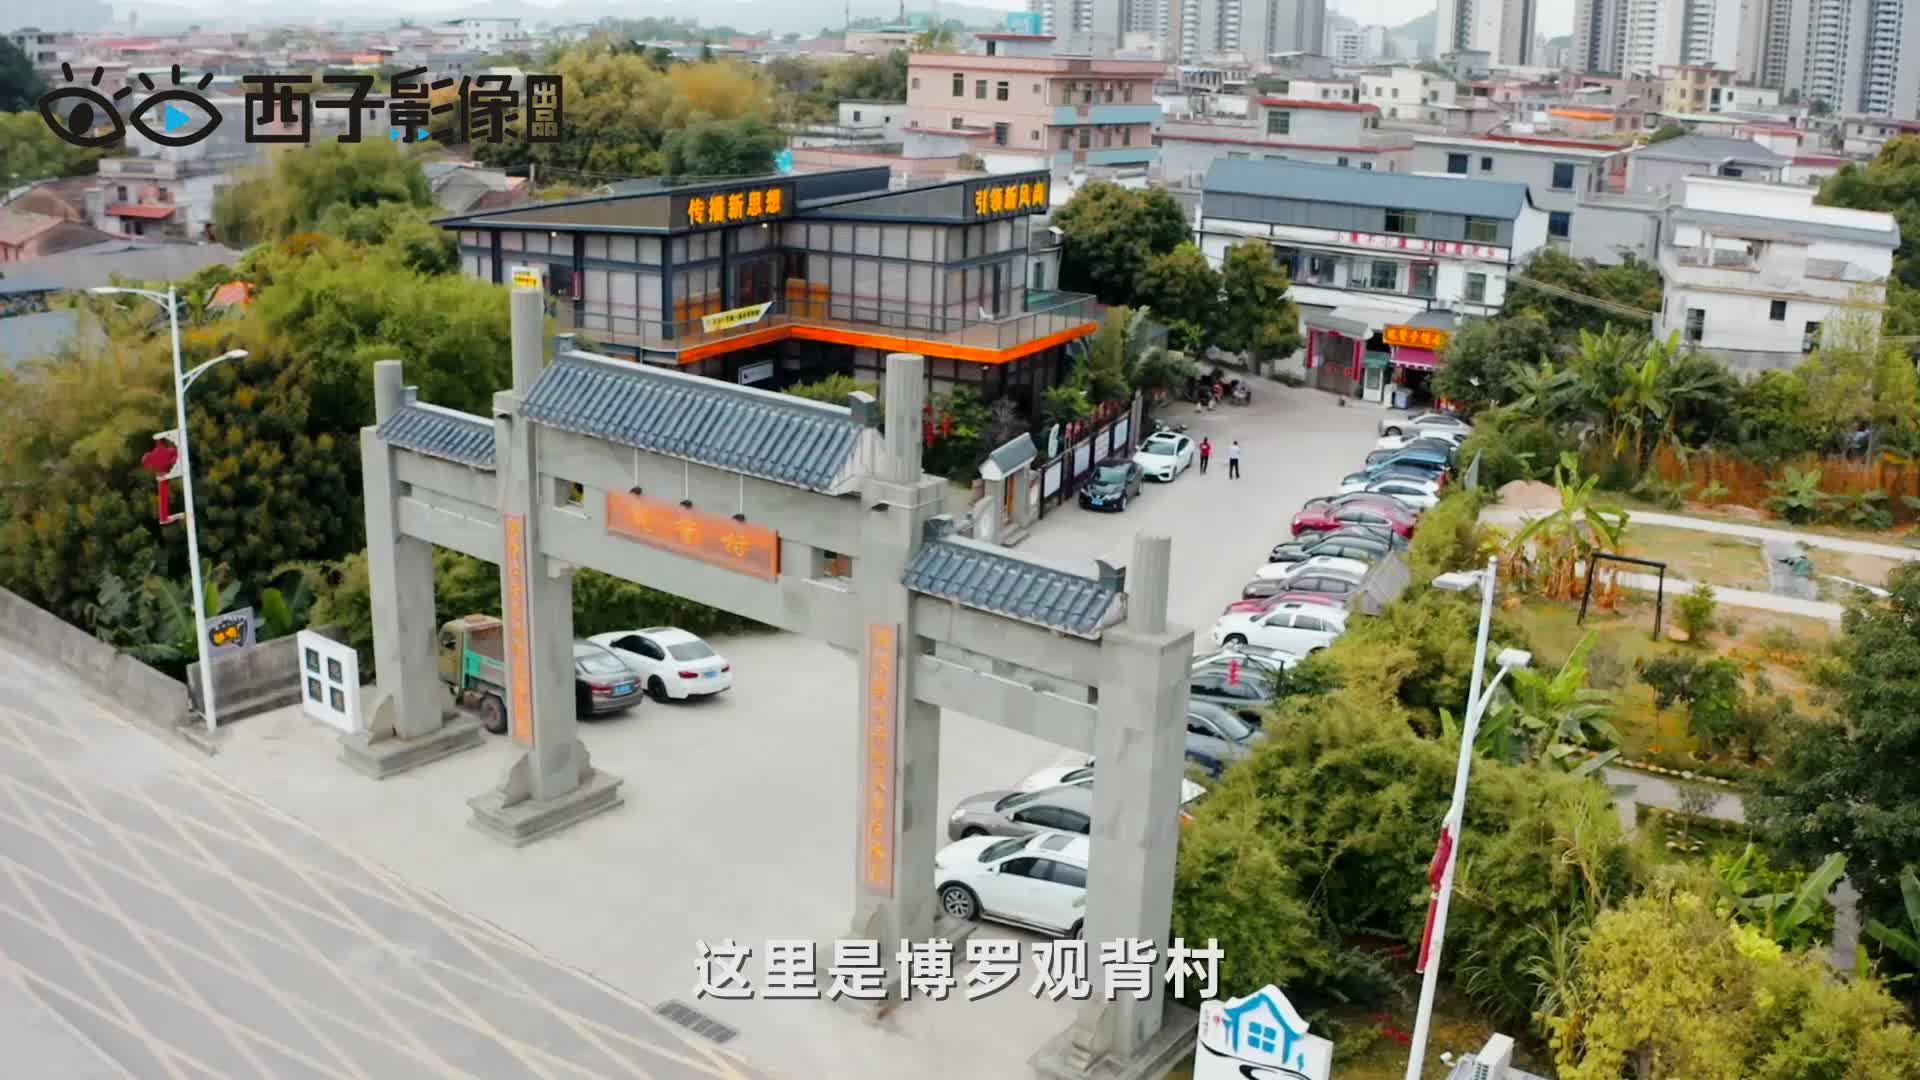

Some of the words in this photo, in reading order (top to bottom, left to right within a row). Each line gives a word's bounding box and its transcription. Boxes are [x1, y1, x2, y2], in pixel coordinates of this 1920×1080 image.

[688, 186, 783, 225] 传播新思想
